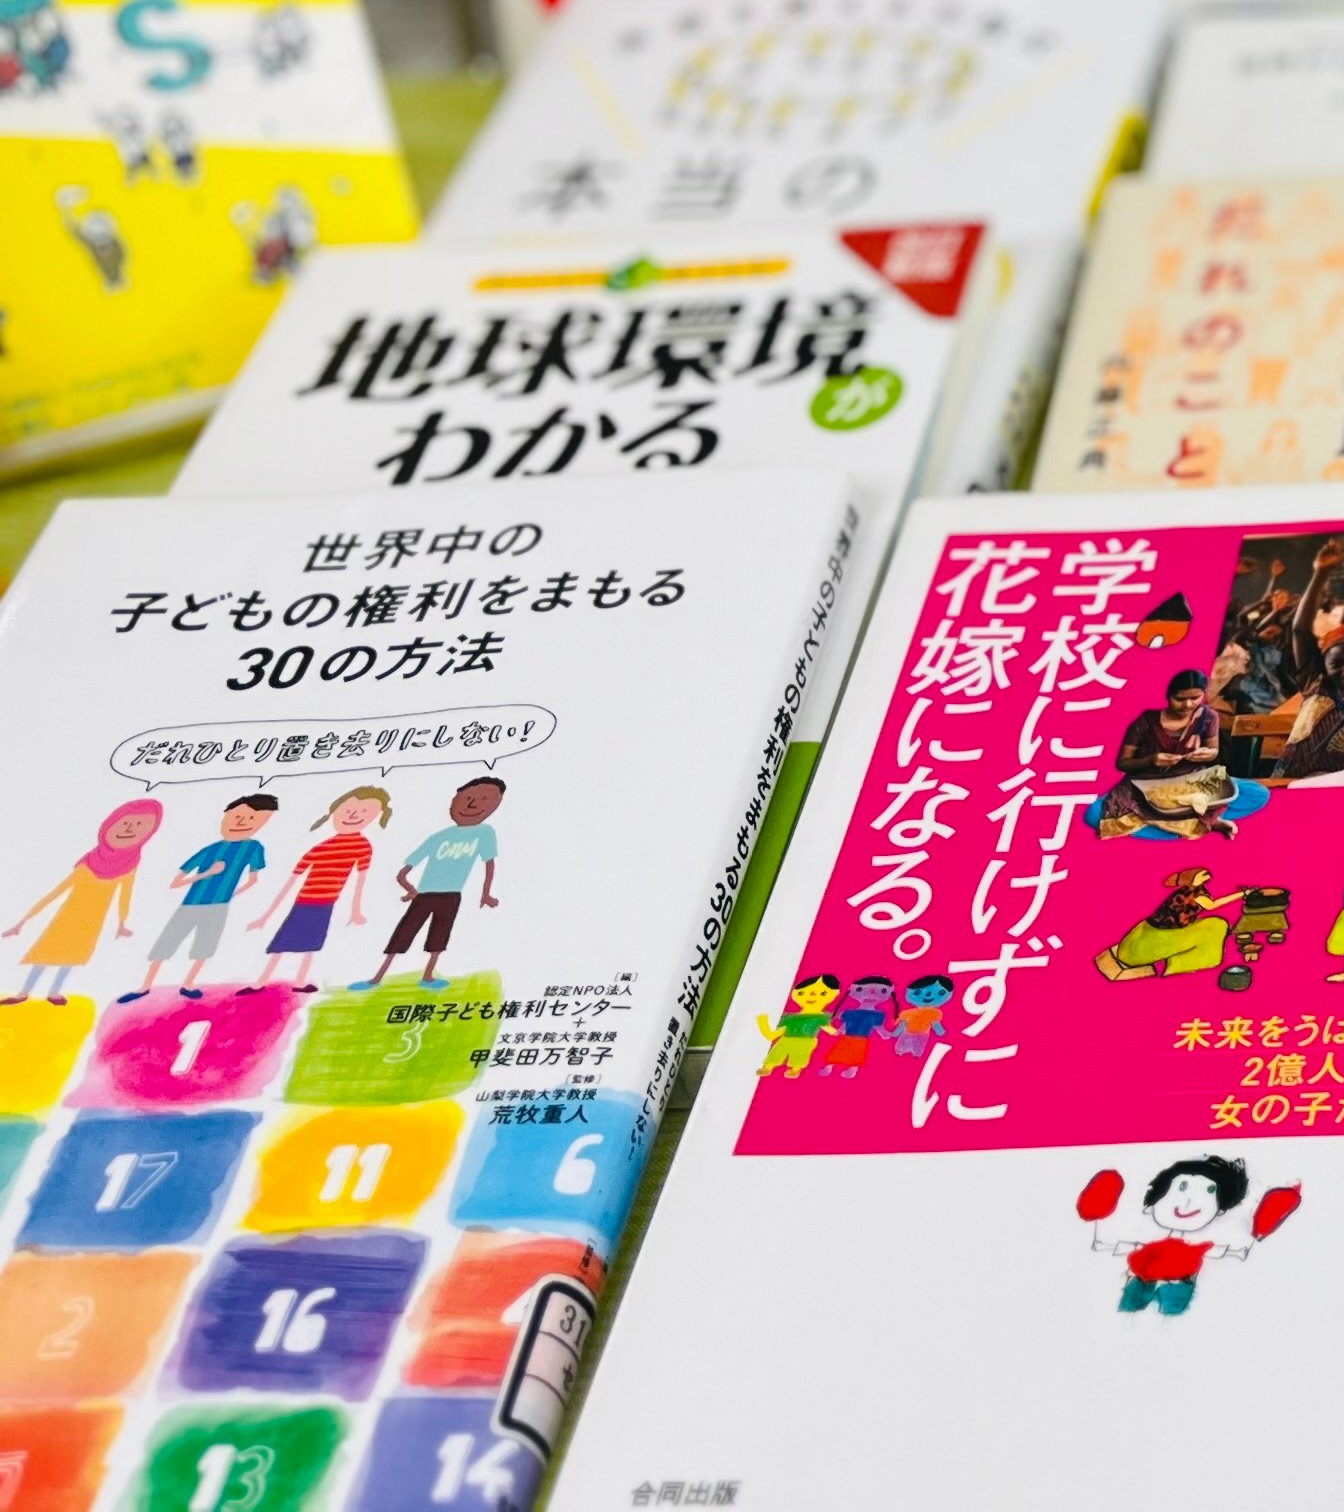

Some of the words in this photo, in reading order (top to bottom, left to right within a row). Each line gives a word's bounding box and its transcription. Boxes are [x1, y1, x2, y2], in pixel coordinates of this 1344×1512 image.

[518, 152, 878, 218] 本当の
[295, 288, 885, 406] 地球環境
[822, 372, 896, 420] が
[376, 398, 722, 486] わかる
[303, 520, 546, 574] 世界中の
[108, 568, 690, 634] 子どもの権利をまもる
[224, 631, 506, 692] 30の方法
[844, 542, 1050, 962] 花嫁になる。
[908, 538, 1160, 1130] 学校に行けずに
[386, 998, 632, 1025] 国際子ども権利センター
[496, 1030, 618, 1044] 文京学院大学教授
[469, 1046, 614, 1069] 甲斐田万智子
[488, 1103, 589, 1126] 荒牧重人
[95, 1151, 179, 1211] 17
[318, 1143, 392, 1202] 11
[552, 1133, 604, 1194] 6
[36, 1296, 94, 1360] 2
[254, 1287, 336, 1352] 16
[188, 1443, 276, 1512] 13
[630, 1479, 744, 1507] 合同出版
